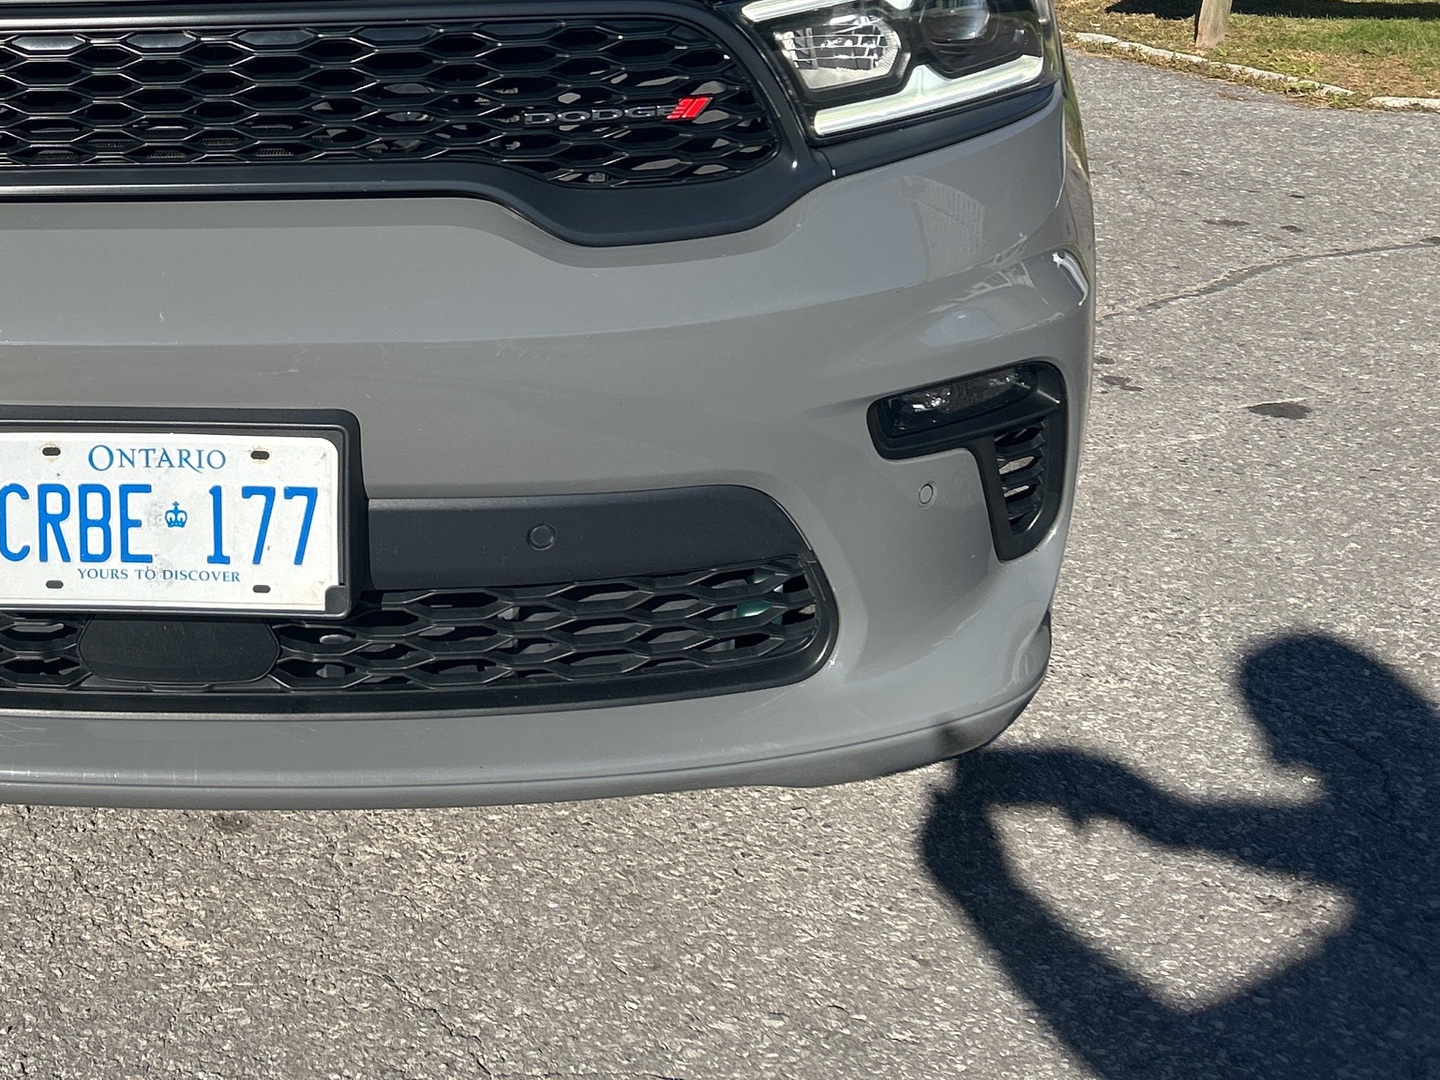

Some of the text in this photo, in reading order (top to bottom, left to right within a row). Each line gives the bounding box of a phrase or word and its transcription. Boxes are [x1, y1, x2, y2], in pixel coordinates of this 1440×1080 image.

[523, 104, 678, 125] DODGE
[88, 444, 227, 474] ONTARIO
[206, 484, 319, 565] 177
[77, 567, 242, 583] YOURS TO DISCOVER
